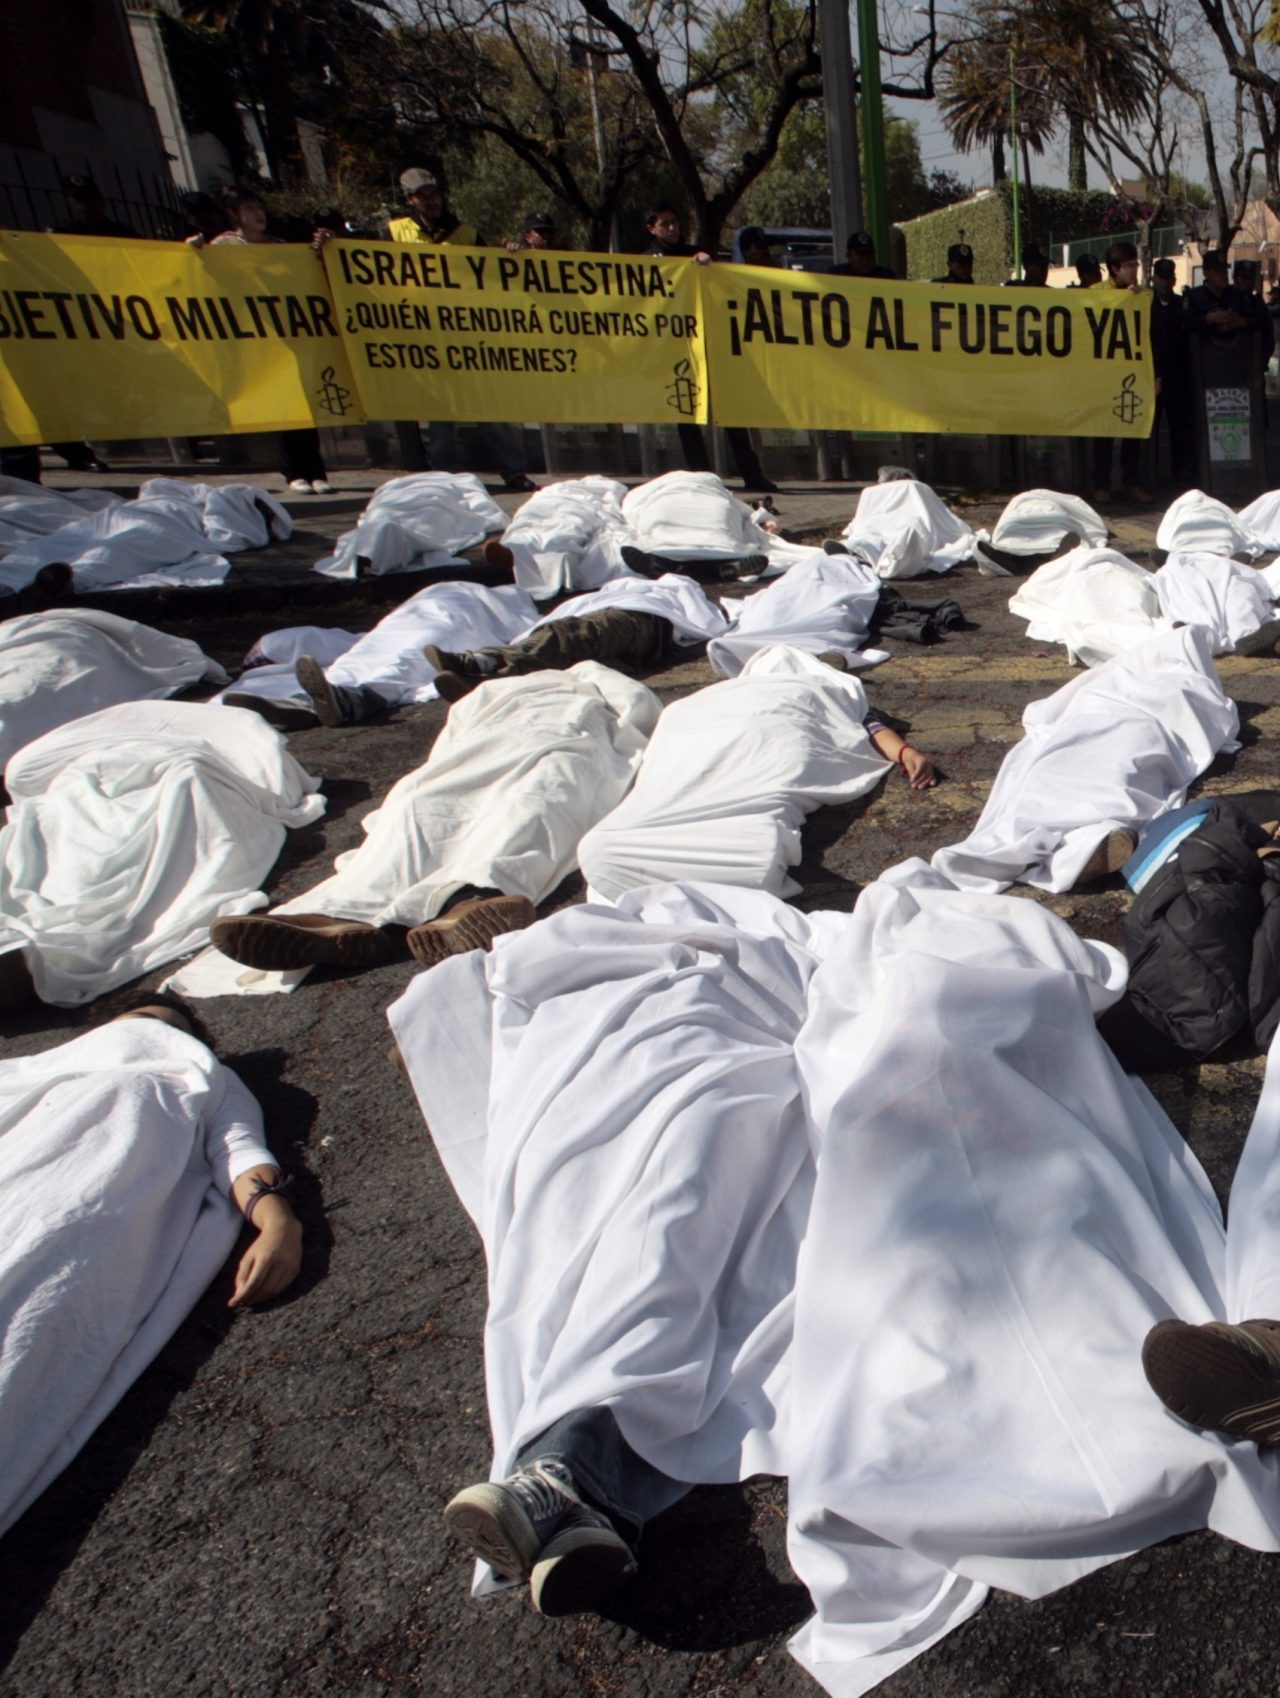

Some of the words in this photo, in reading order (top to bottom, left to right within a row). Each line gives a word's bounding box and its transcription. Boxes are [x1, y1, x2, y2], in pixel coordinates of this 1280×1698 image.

[338, 248, 461, 290] ISRAEL
[466, 255, 486, 290] Y
[497, 257, 676, 299] PALESTINA:
[164, 295, 339, 341] MILITAR
[345, 298, 432, 334] ¿QUIÉN
[437, 304, 543, 335] RENDIRÁ
[549, 311, 650, 338] CUENTAS
[655, 314, 699, 339] POR
[727, 288, 851, 356] ¡ALTO
[865, 296, 919, 352] AL
[929, 301, 1073, 358] FUEGO
[1083, 307, 1143, 361] YA!
[364, 342, 441, 370] ESTOS
[445, 340, 578, 373] CRÍMENES?
